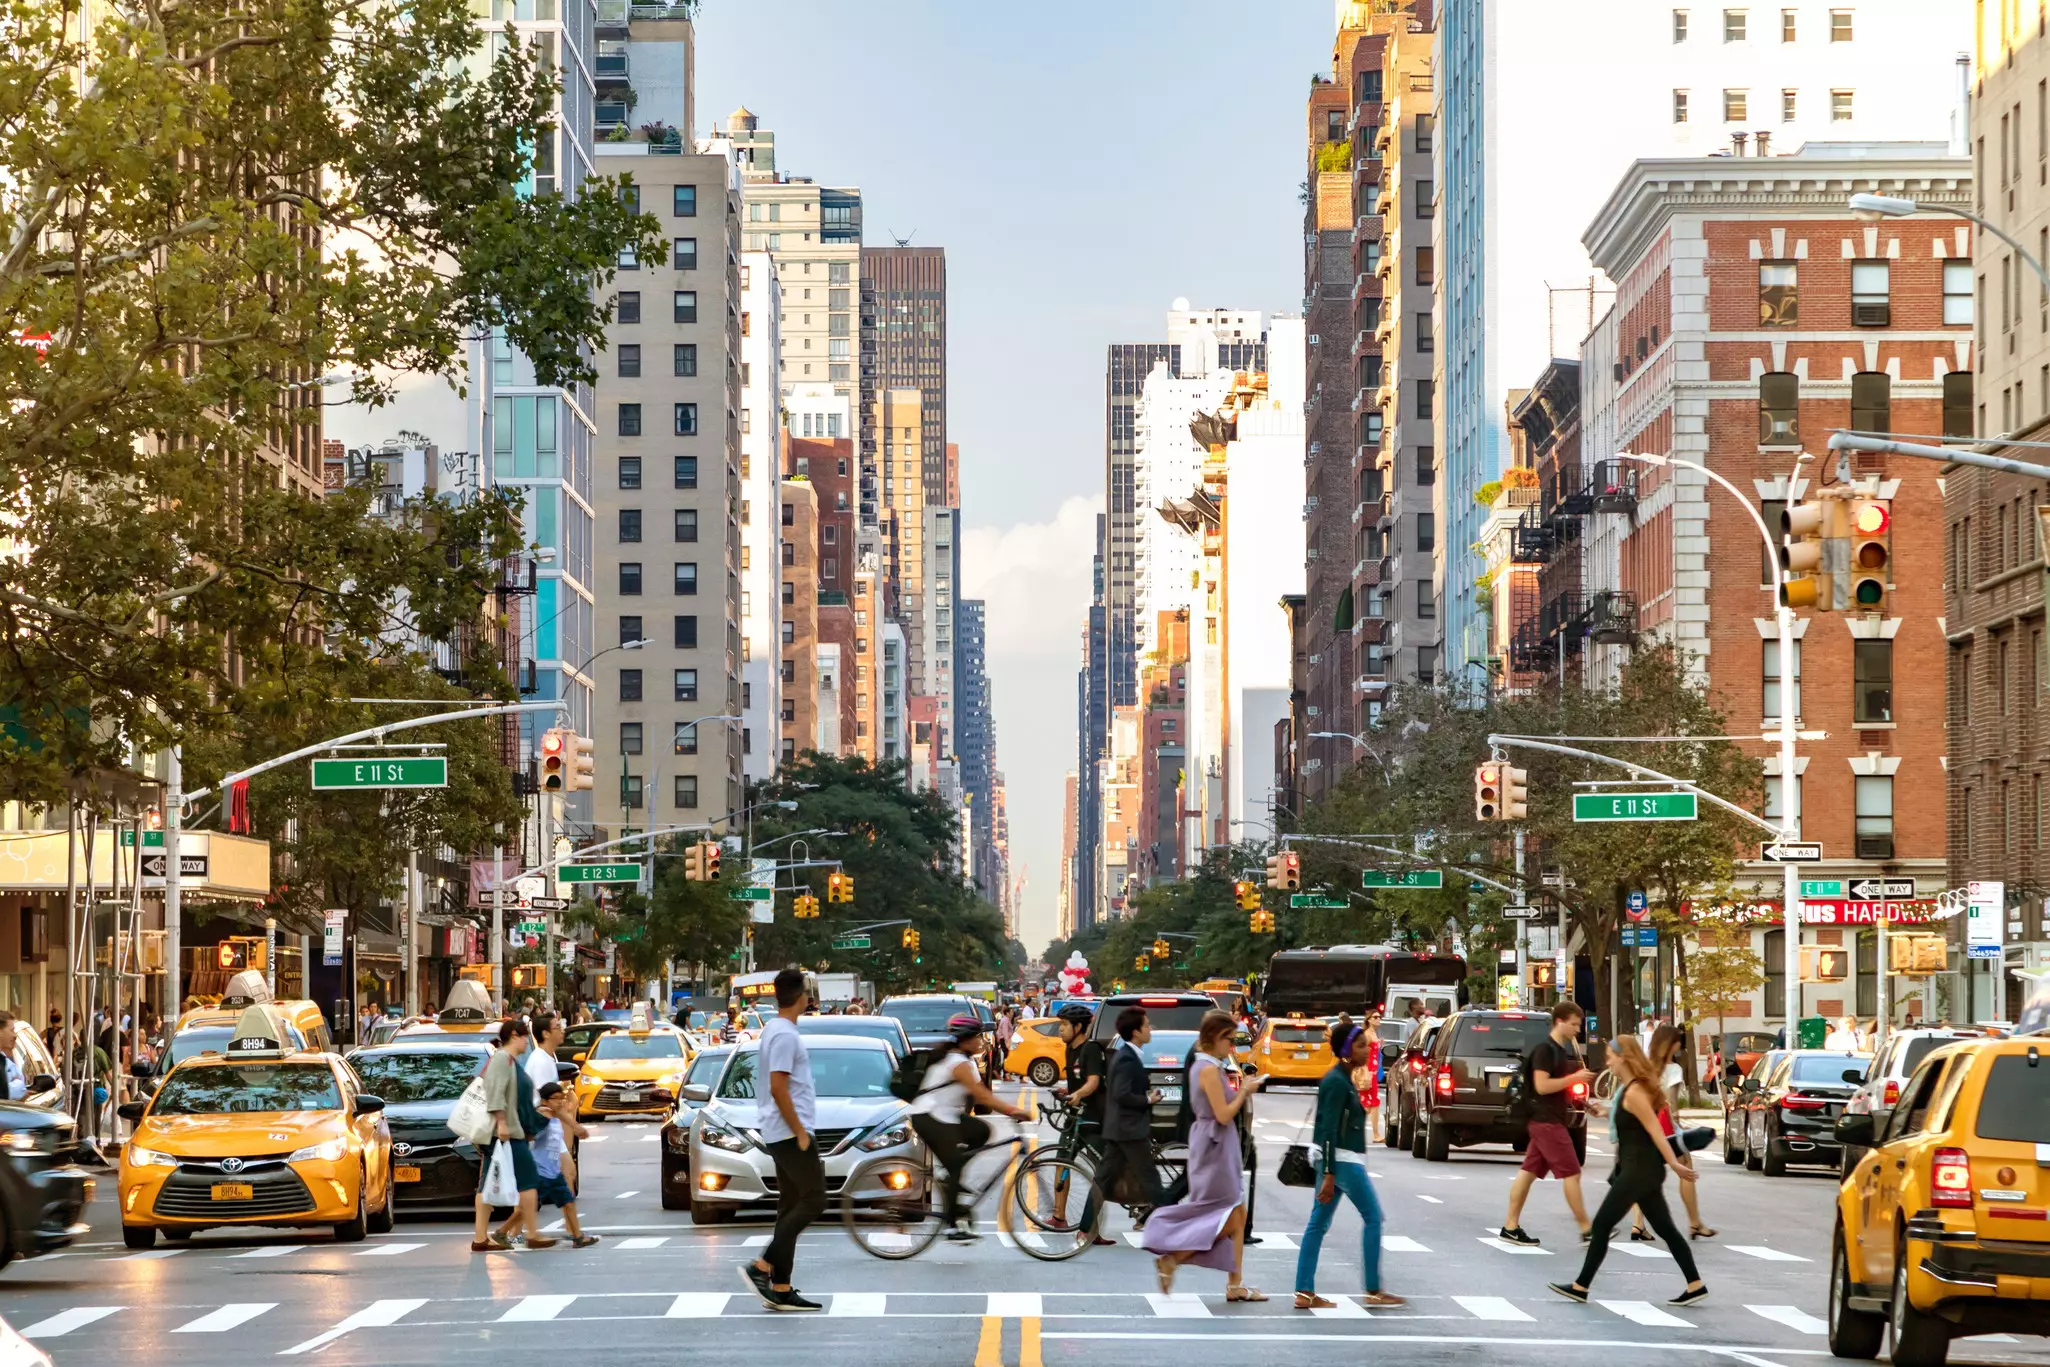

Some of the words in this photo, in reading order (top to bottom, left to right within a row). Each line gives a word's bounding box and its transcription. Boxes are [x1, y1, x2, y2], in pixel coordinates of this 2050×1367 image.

[355, 765, 364, 781] E
[371, 765, 380, 781] 11
[388, 765, 403, 781] St
[1613, 800, 1621, 814] E
[1628, 800, 1636, 814] 11
[1643, 799, 1657, 814] St
[126, 833, 132, 845] E
[582, 868, 588, 879] E
[593, 868, 602, 879] 12
[606, 868, 616, 878] St
[1408, 874, 1418, 884] St
[1806, 883, 1812, 894] E
[1817, 883, 1823, 893] 11
[1861, 886, 1879, 894] ONE
[1888, 886, 1908, 894] WAY
[1797, 902, 1836, 922] lus
[455, 1009, 470, 1018] 7C47
[242, 1038, 264, 1049] 8H94
